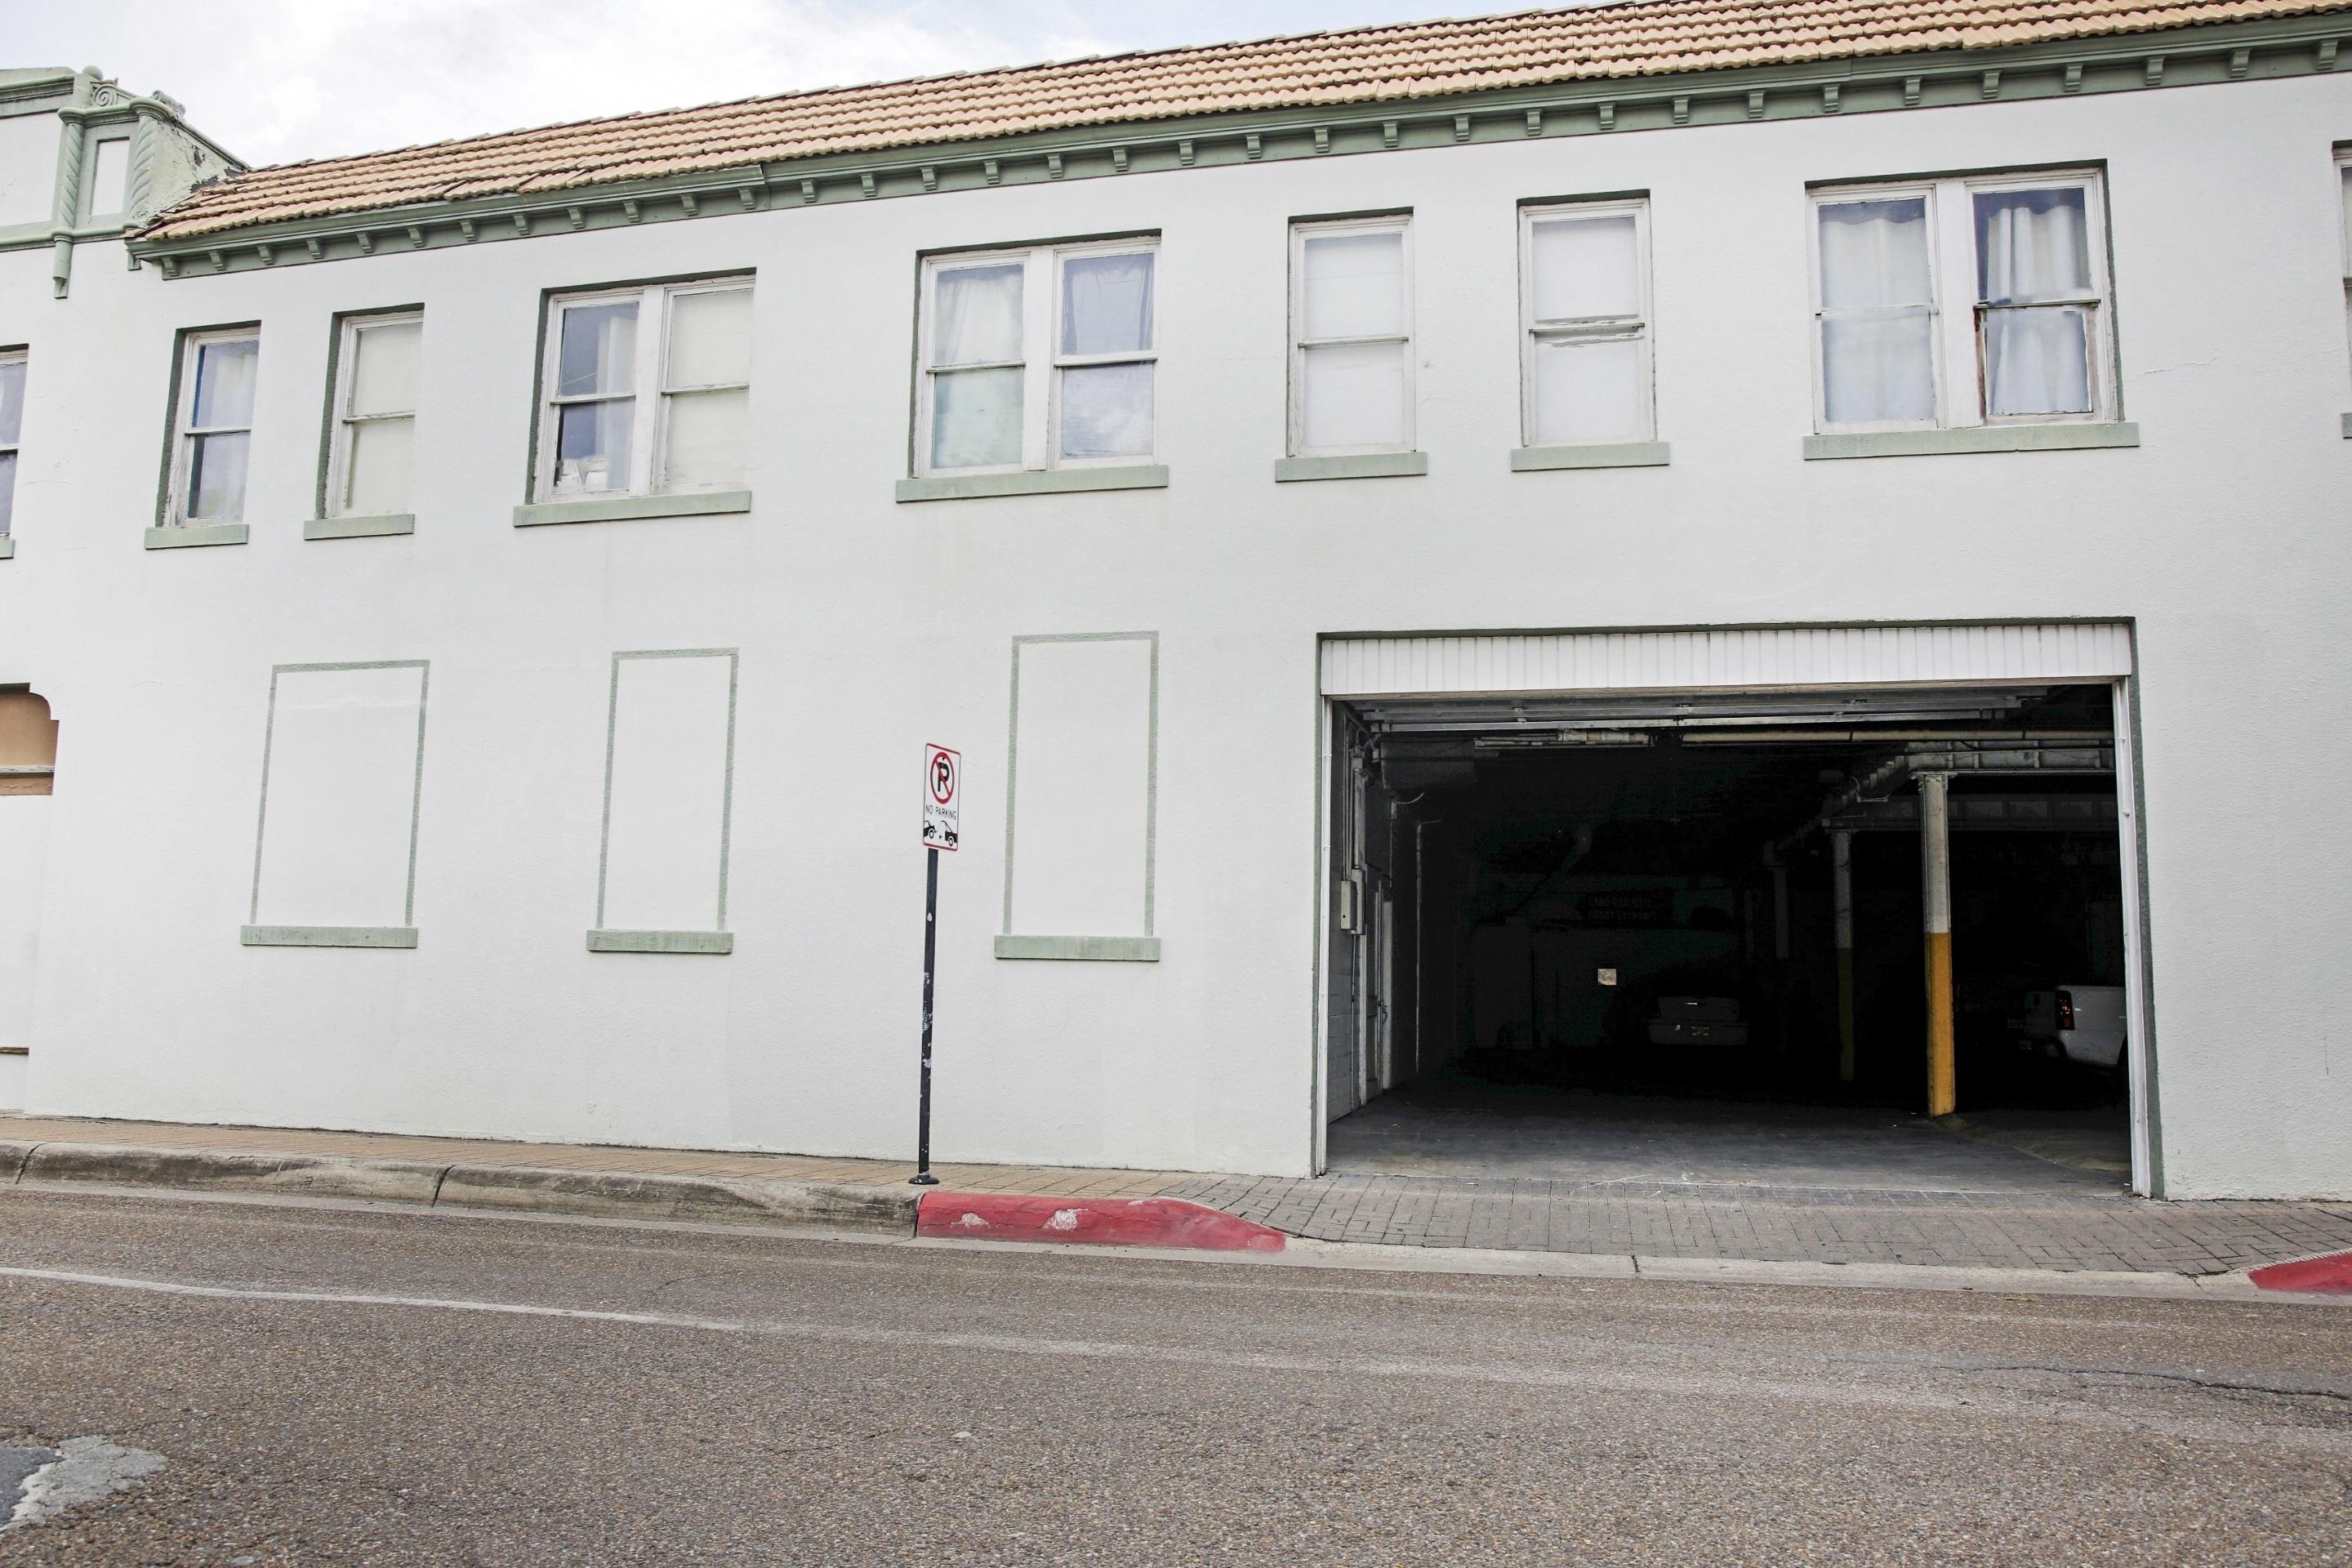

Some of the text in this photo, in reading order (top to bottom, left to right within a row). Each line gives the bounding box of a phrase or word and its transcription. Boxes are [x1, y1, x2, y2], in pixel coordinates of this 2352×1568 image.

[938, 762, 950, 791] P
[925, 804, 956, 820] NO PARKING
